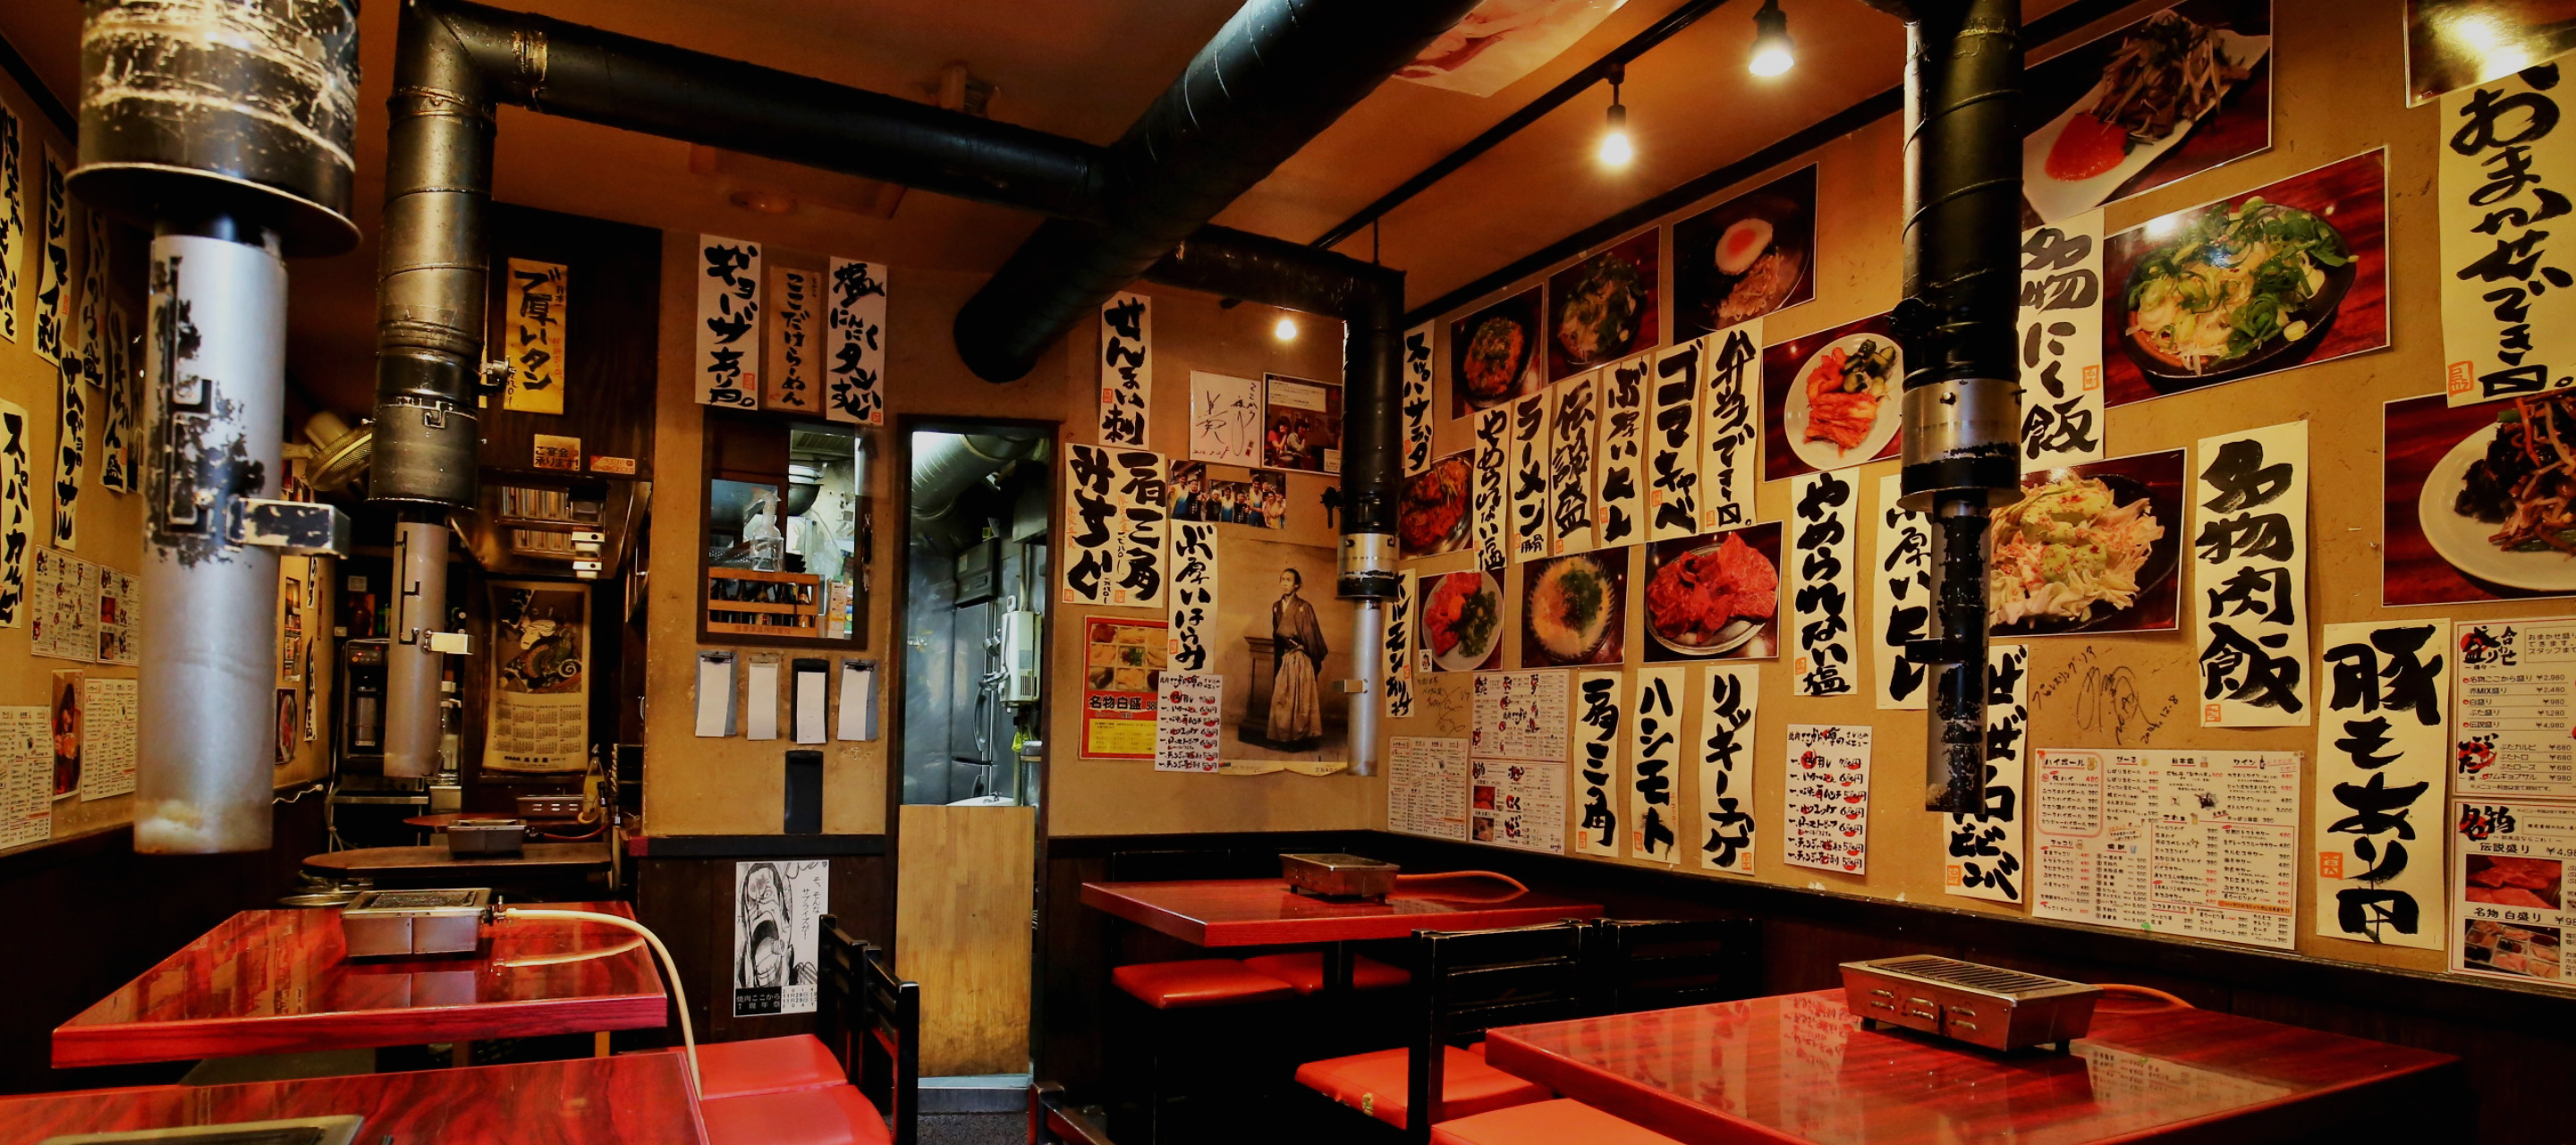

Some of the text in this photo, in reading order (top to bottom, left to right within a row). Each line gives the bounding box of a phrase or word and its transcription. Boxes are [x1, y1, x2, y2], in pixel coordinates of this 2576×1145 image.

[781, 273, 810, 406] ここだけらーめん
[1102, 297, 1146, 445] せんまい刺
[1475, 410, 1508, 572] やめられない塩
[1515, 394, 1546, 537] ラーメン
[1553, 379, 1595, 539] 伝説盛
[1654, 339, 1704, 534] ゴマキャベ
[1796, 472, 1852, 695] やめられない塩
[1089, 695, 1142, 710] 名物白盛
[1580, 677, 1620, 847] 肩三角
[1636, 677, 1674, 854] ハシモト
[2044, 758, 2086, 767] ハイボール
[2474, 907, 2499, 918] 名物
[2504, 911, 2541, 922] 白盛り
[2479, 843, 2529, 854] 伝説盛り
[736, 992, 781, 1003] 焼肉ここから
